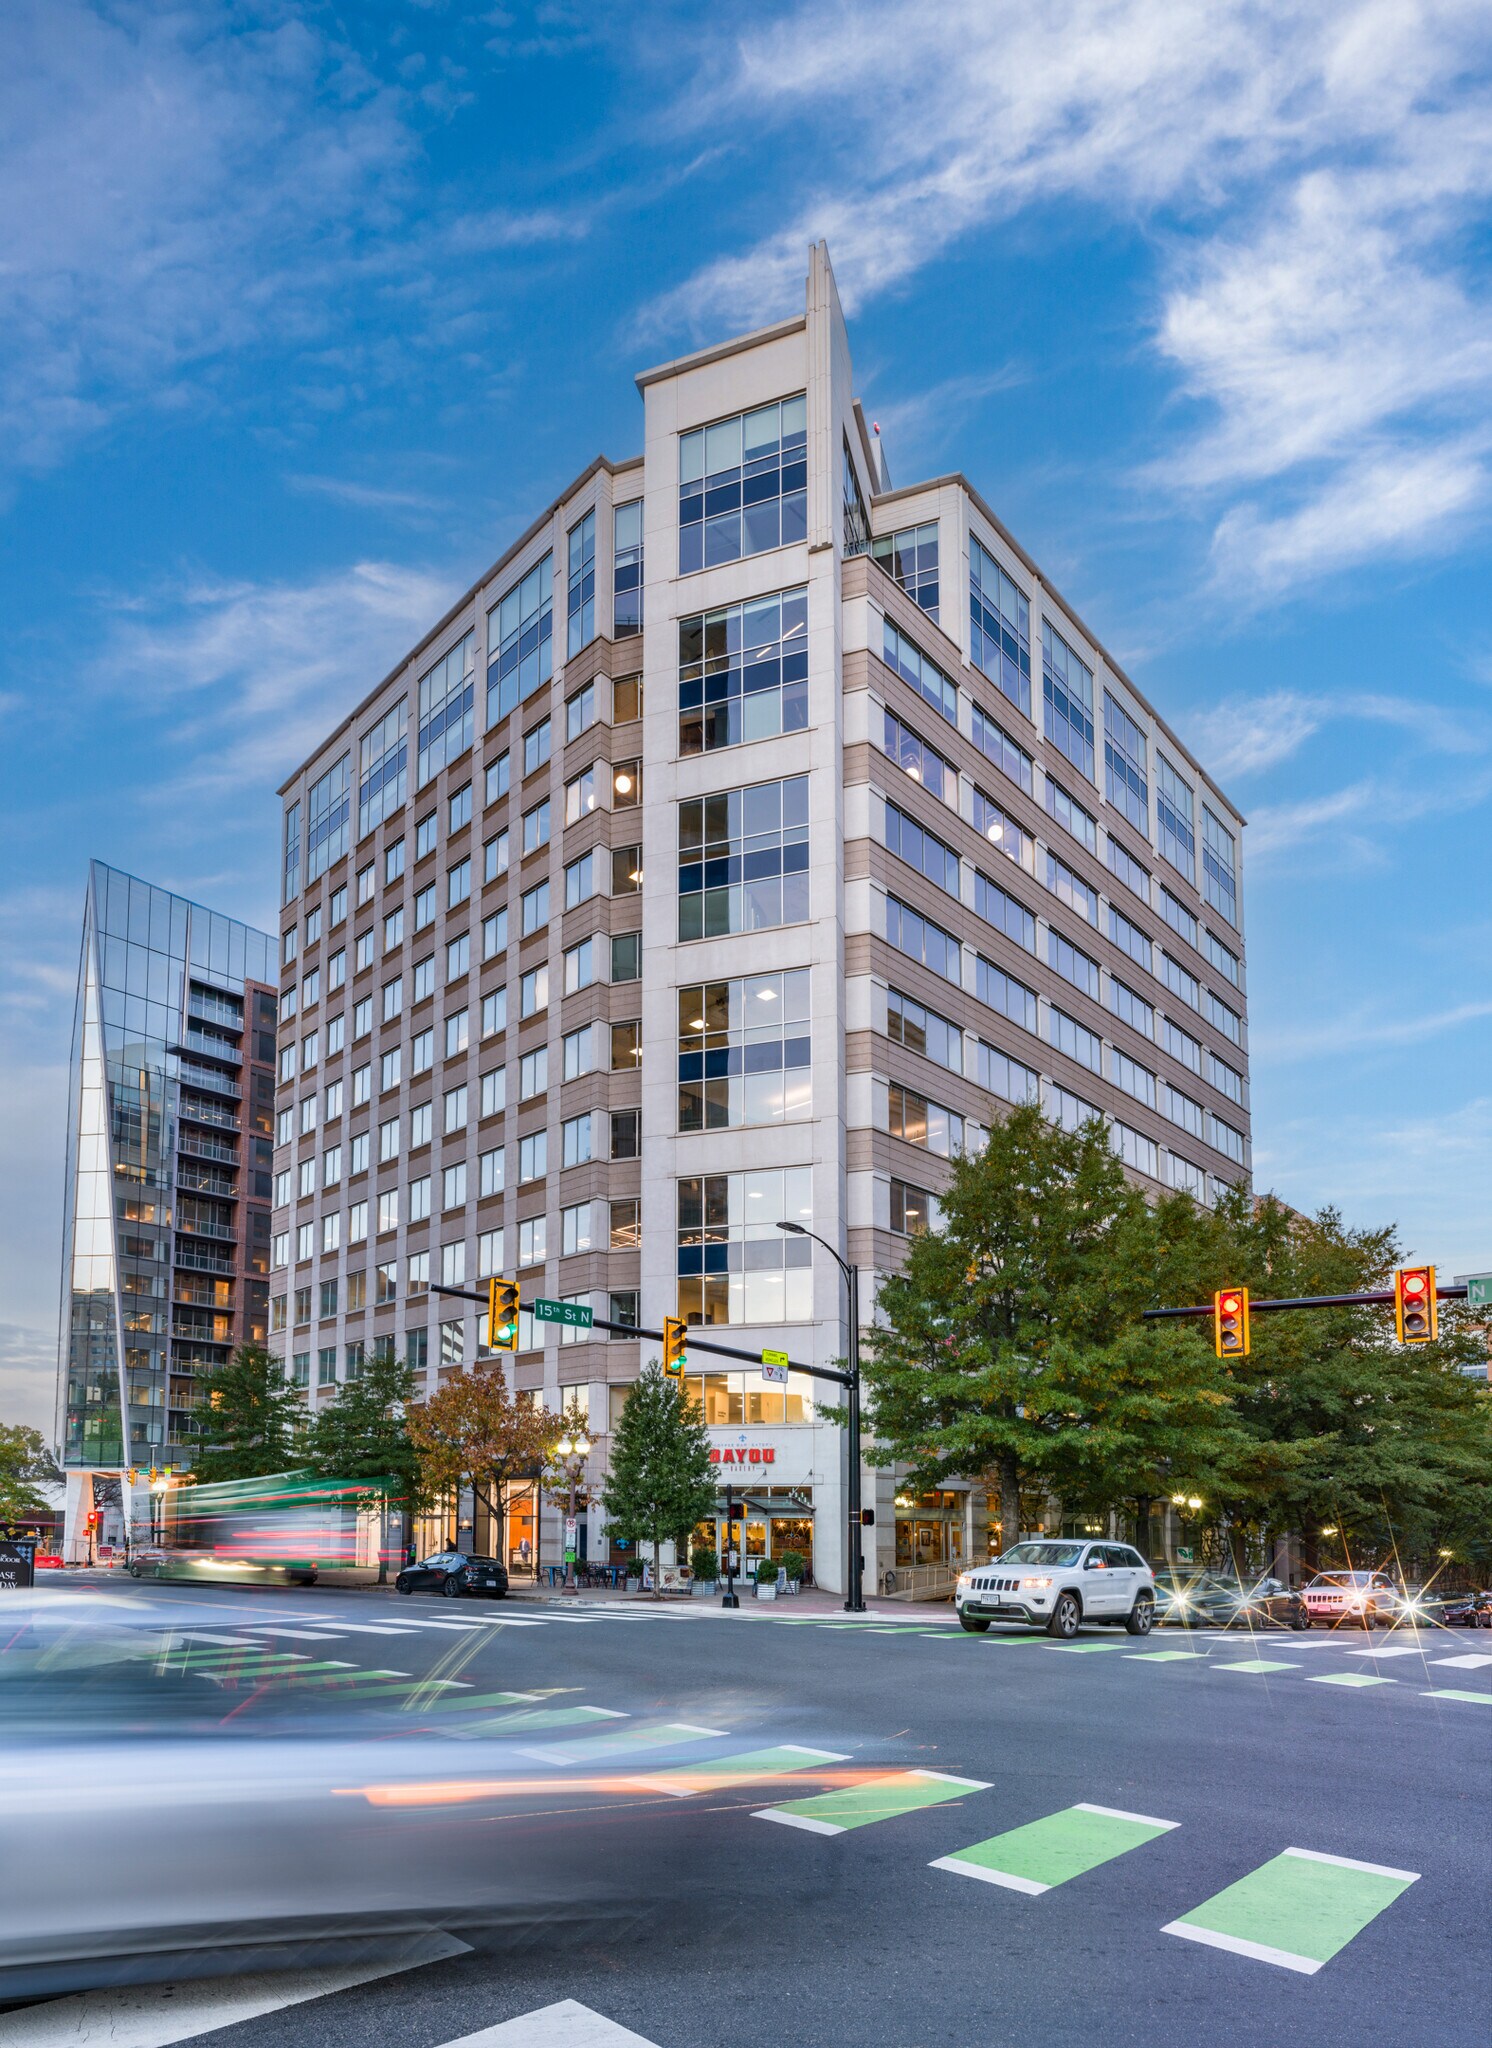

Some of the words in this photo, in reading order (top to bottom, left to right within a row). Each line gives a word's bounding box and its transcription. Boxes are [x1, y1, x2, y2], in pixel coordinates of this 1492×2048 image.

[1472, 1284, 1485, 1298] N
[539, 1304, 560, 1317] 15th
[564, 1309, 576, 1321] St
[581, 1311, 590, 1323] N
[709, 1448, 775, 1463] BAYOU
